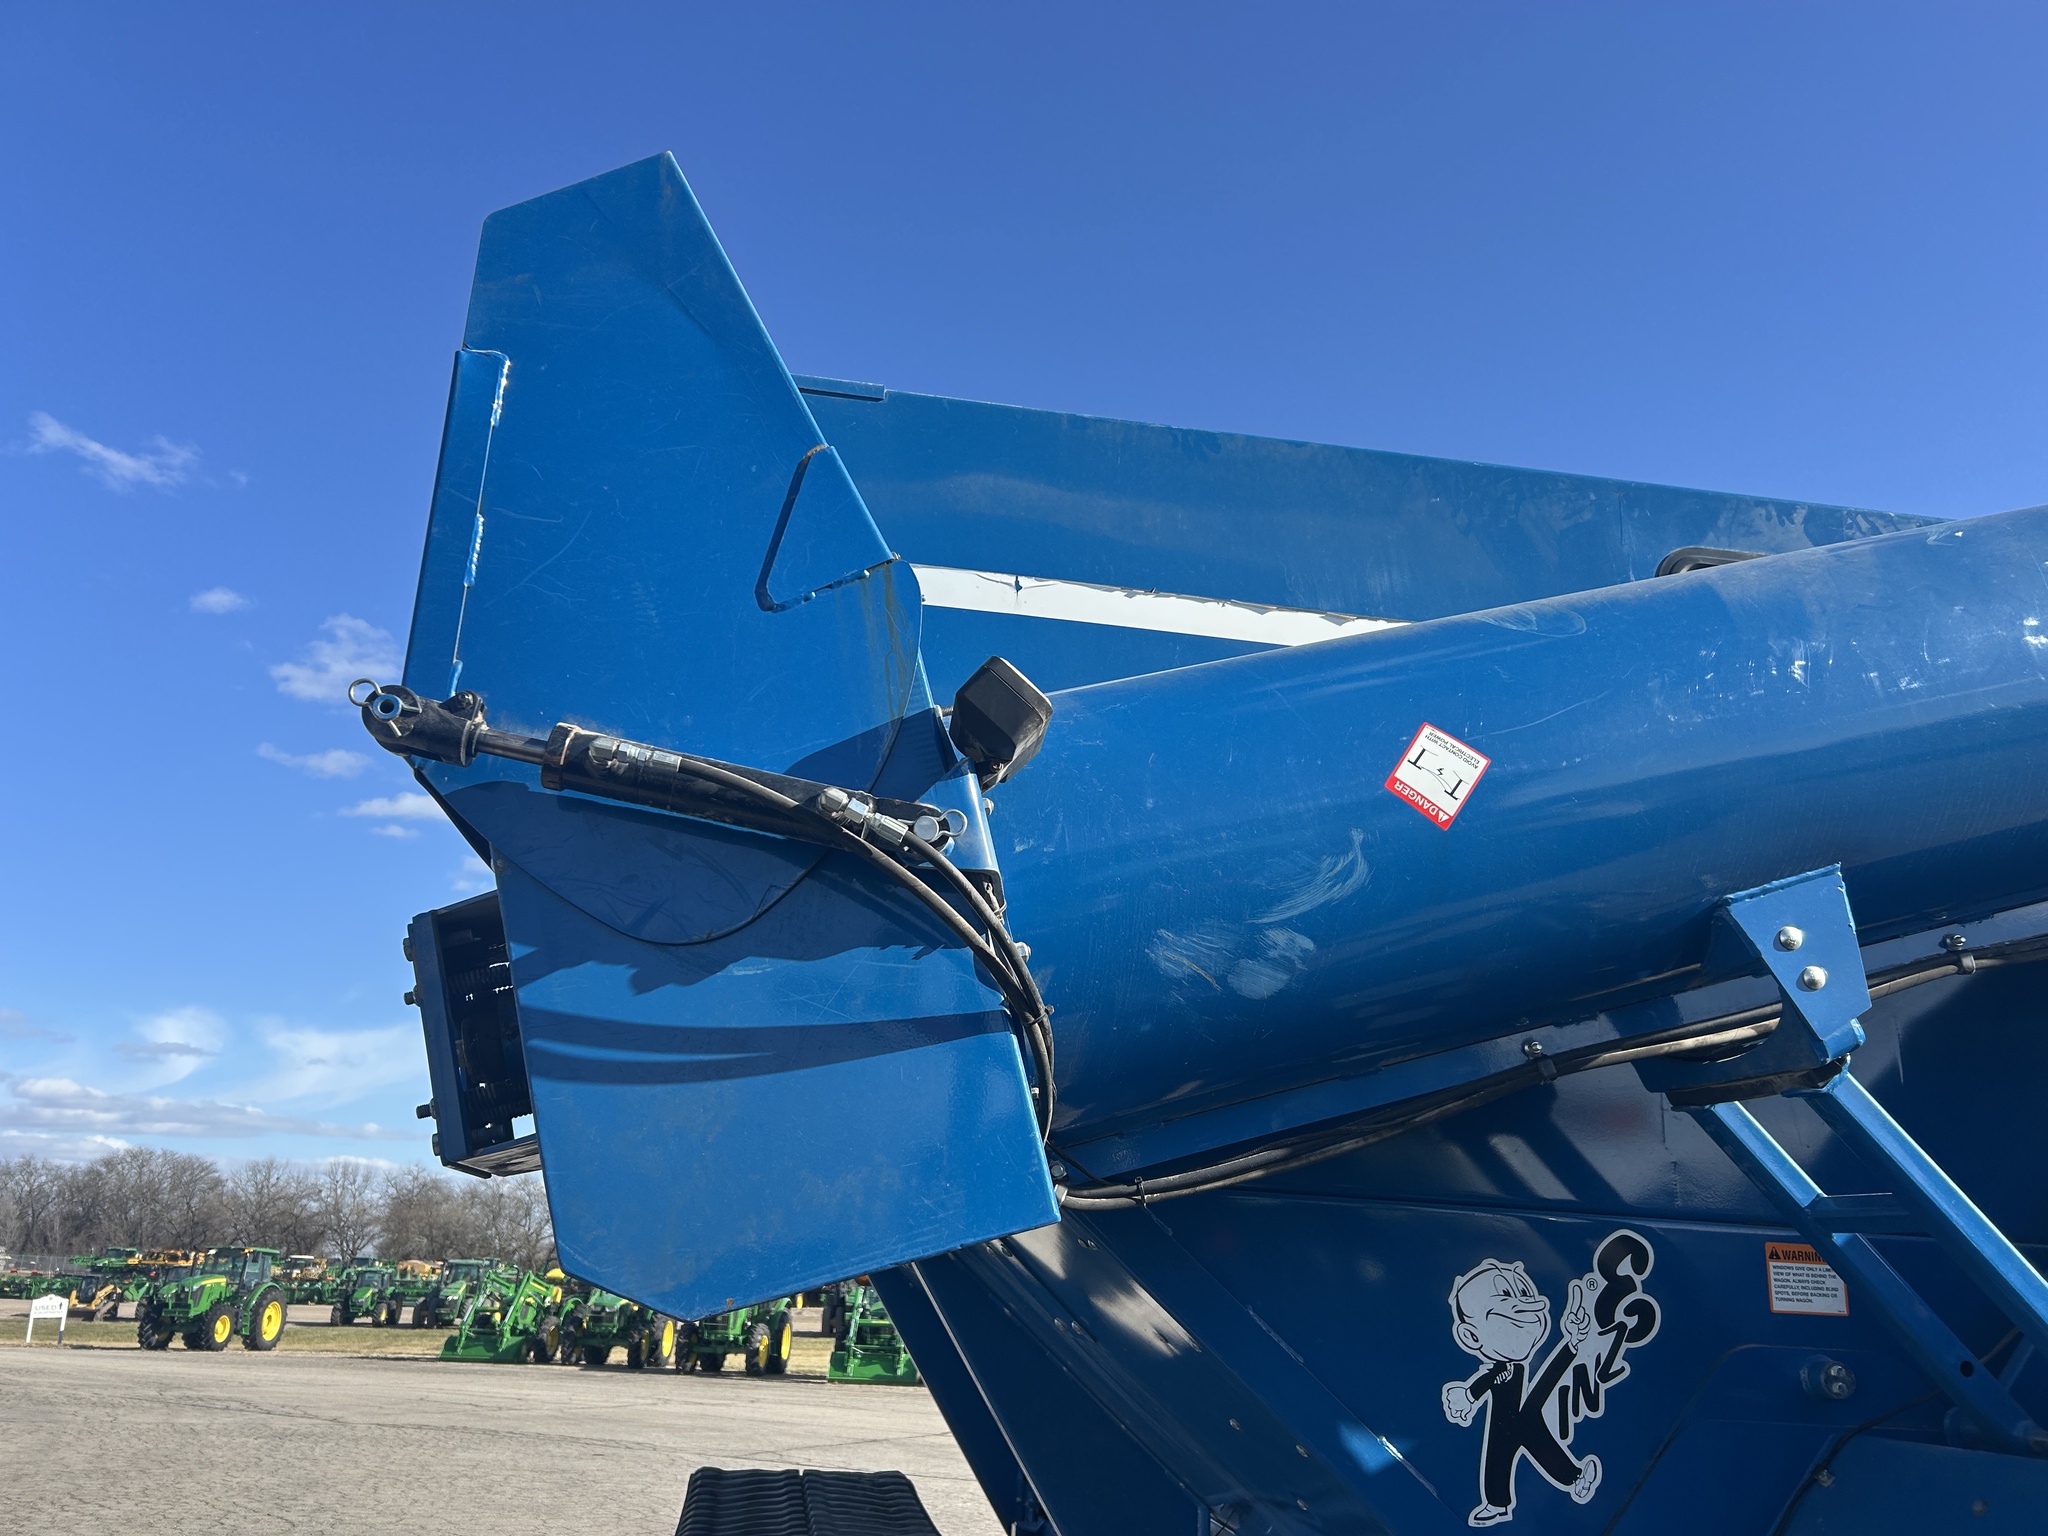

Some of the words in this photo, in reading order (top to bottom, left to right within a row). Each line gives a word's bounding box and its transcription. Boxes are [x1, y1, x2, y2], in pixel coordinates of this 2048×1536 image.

[1424, 734, 1439, 745] WITH
[1428, 731, 1449, 746] POWER
[1438, 742, 1463, 760] CONTACT
[1448, 742, 1480, 765] ELECTRICAL
[1462, 757, 1479, 770] AVOID
[1393, 780, 1439, 816] DANGER
[1782, 1250, 1826, 1262] WARNIN
